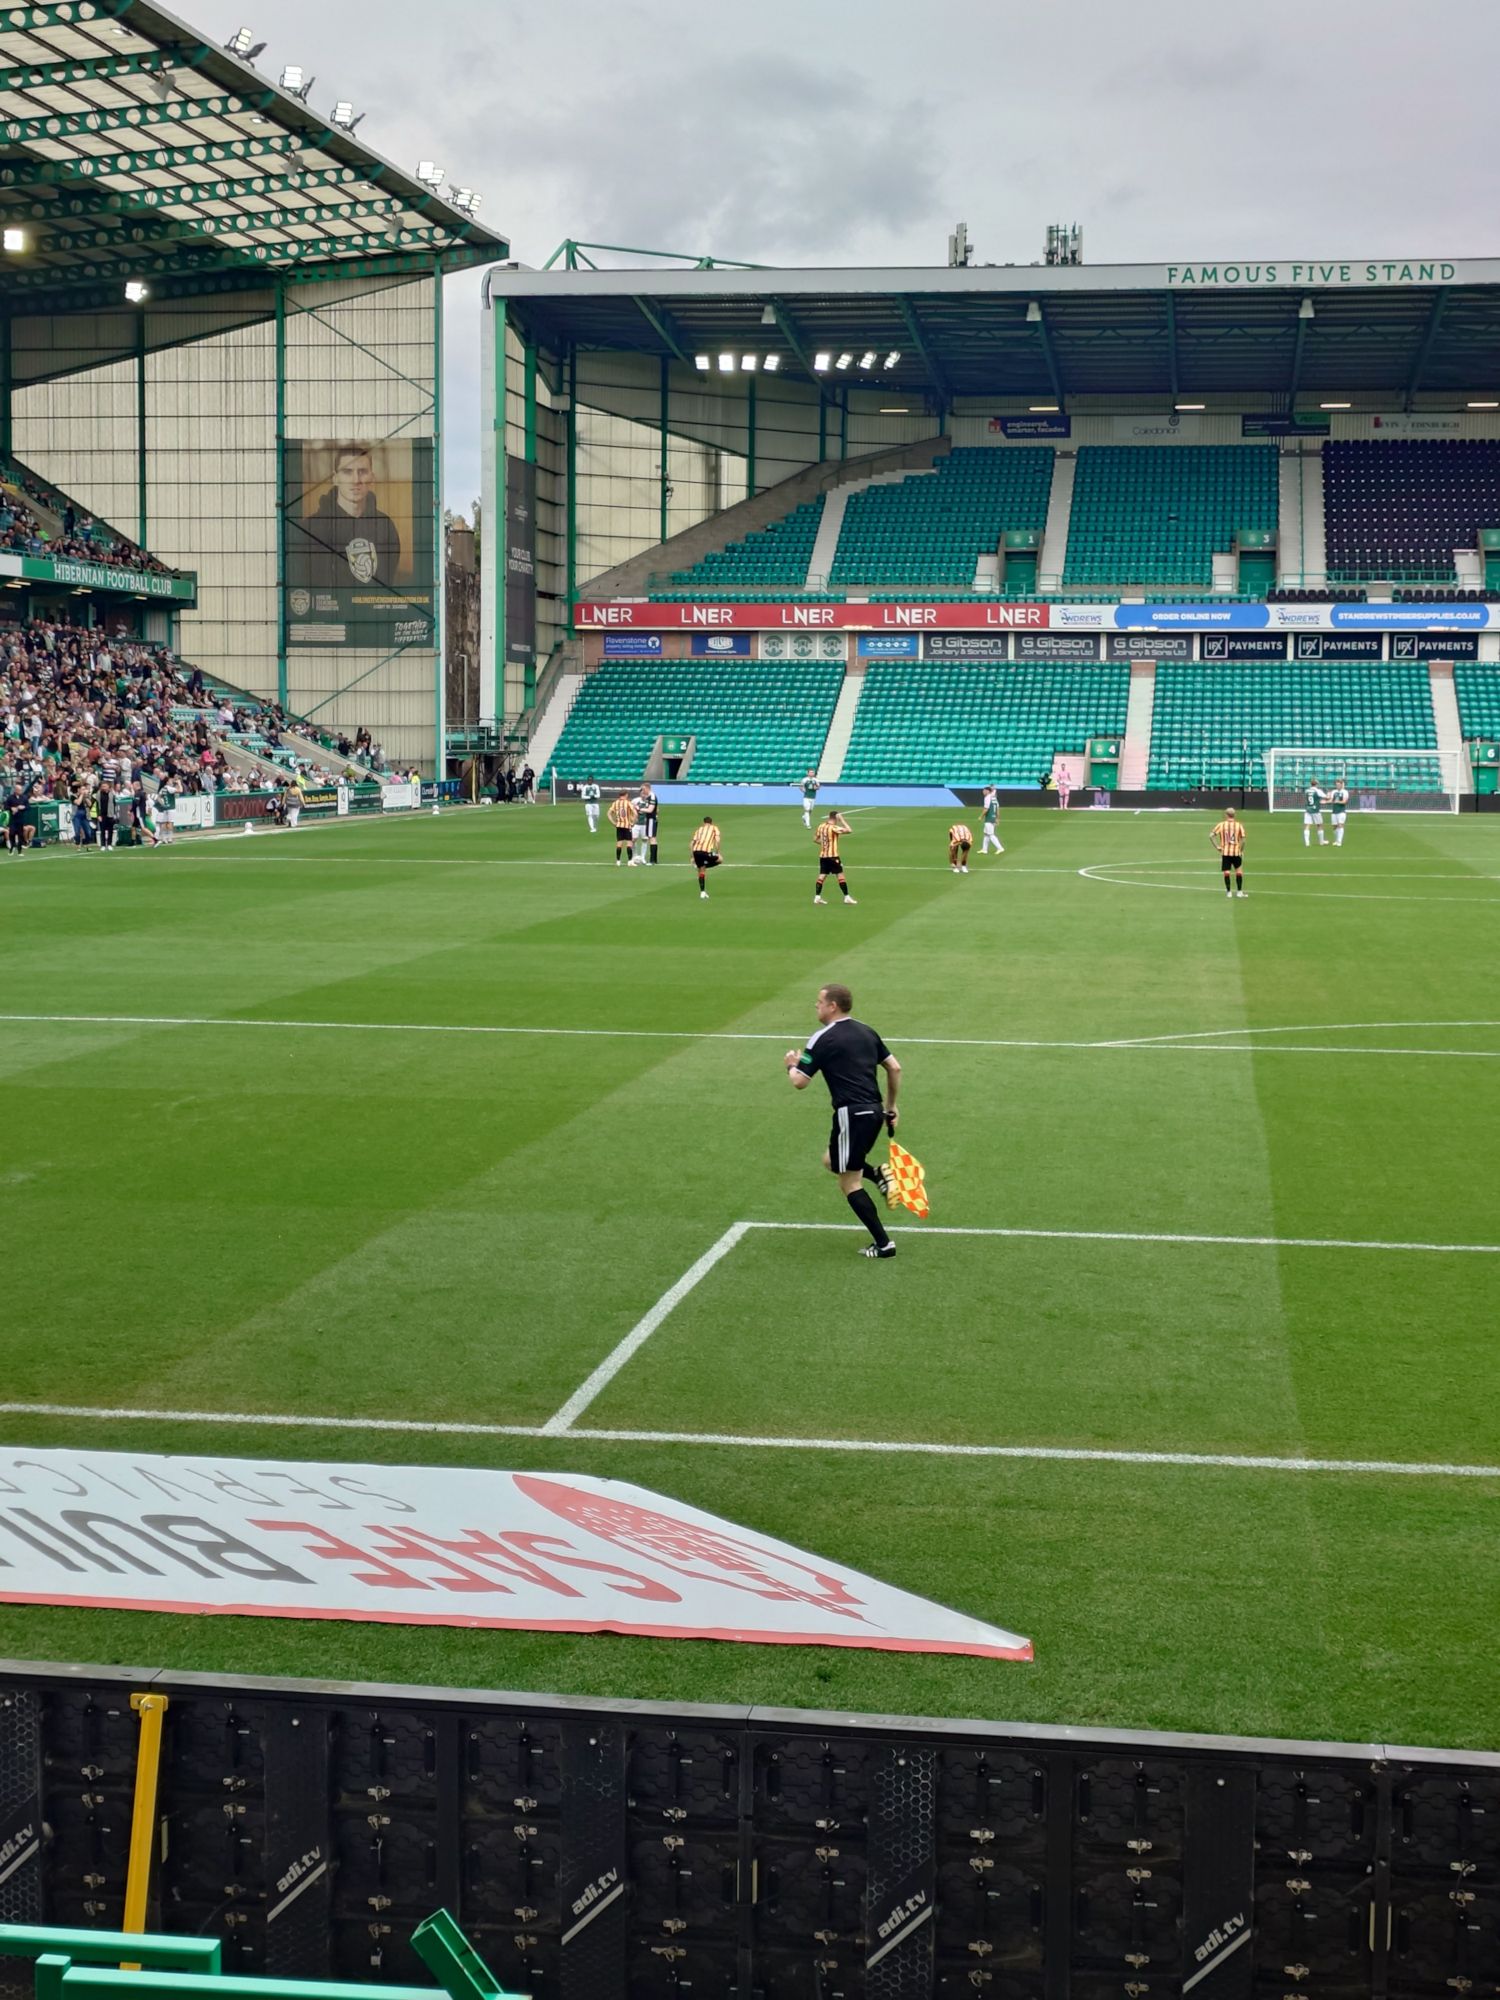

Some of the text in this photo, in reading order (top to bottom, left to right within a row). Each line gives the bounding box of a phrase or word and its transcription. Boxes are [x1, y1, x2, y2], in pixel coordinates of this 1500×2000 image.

[1167, 263, 1456, 284] FAMOUS FIVE STAND
[1132, 426, 1180, 435] Caledonian
[1028, 535, 1035, 544] 1
[1263, 534, 1270, 543] 3
[53, 563, 172, 595] HIBERNIAN FOOTBALL CLUB
[581, 605, 633, 625] LNER
[681, 605, 733, 625] LNER
[781, 606, 834, 626] LNER
[883, 606, 937, 626] LNER
[986, 606, 1041, 626] LNER
[1152, 613, 1231, 621] ORDER ONLINE NOW
[1338, 612, 1481, 620] STANDREWSTIMBERSUPPLIES.CO.UK
[930, 637, 1001, 648] G Gibson
[1021, 637, 1093, 648] G Gibson
[1113, 637, 1187, 648] G Gibson
[1229, 641, 1283, 650] PAYMENTS
[1323, 641, 1378, 650] PAYMENTS
[1418, 642, 1474, 650] PAYMENTS
[680, 741, 687, 750] 2
[1108, 745, 1116, 754] 4
[1487, 749, 1495, 758] 6
[1308, 796, 1315, 805] 9
[0, 1460, 417, 1513] SERVIC
[0, 1507, 683, 1603] SAFE BUIL
[276, 1846, 320, 1892] adi.tv
[571, 1867, 618, 1915] adi.tv
[877, 1890, 926, 1938] adi.tv
[1194, 1912, 1244, 1961] adi.tv
